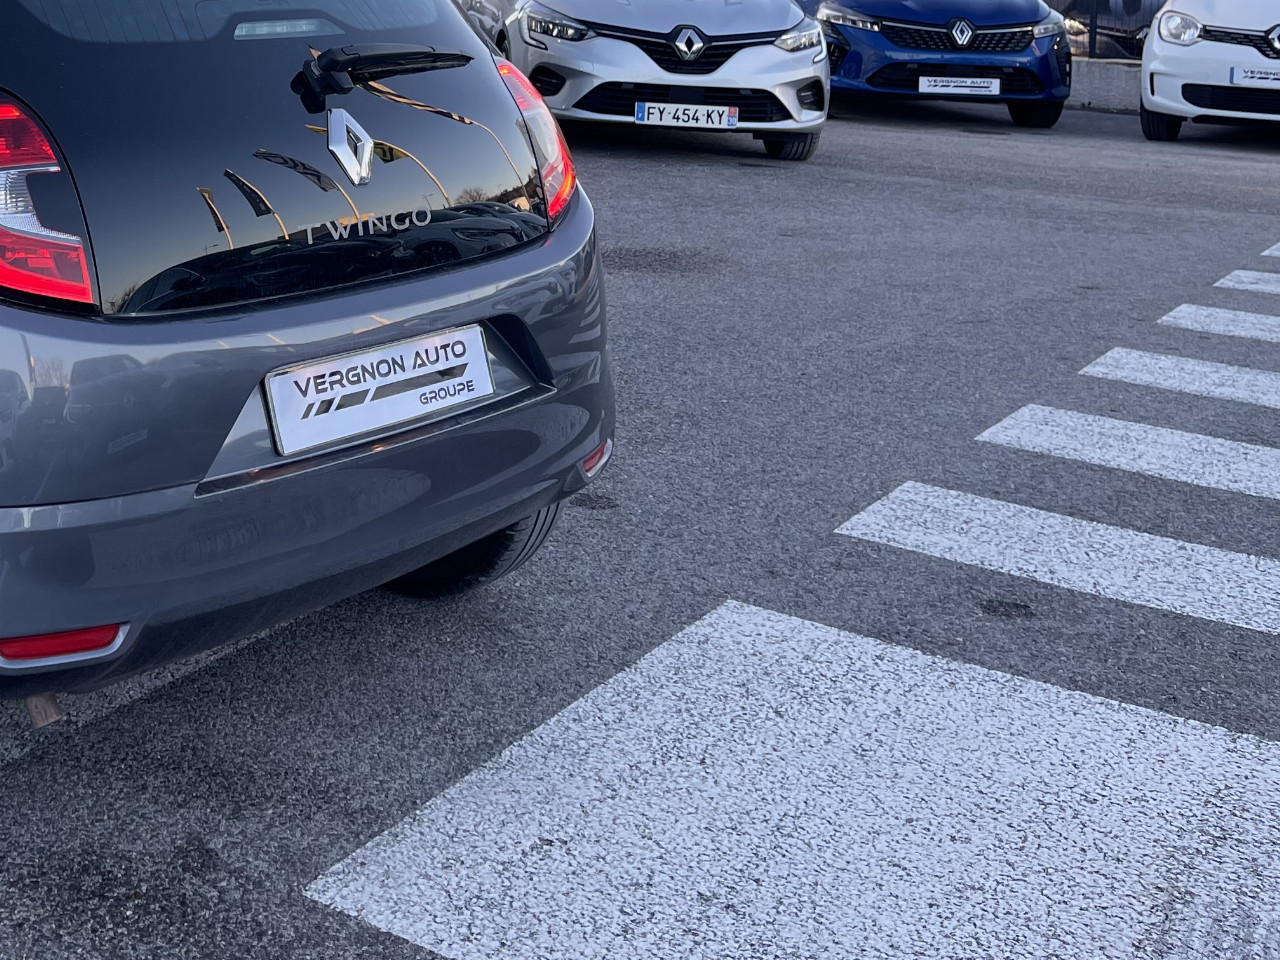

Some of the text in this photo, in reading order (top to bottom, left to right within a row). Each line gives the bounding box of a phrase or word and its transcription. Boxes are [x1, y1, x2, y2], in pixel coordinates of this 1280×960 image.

[1243, 69, 1280, 77] VERGNO
[646, 106, 726, 125] FY-454-KY
[297, 207, 432, 245] TWINGO
[293, 340, 467, 398] VERGNON AUTO
[419, 379, 475, 405] GROUPE
